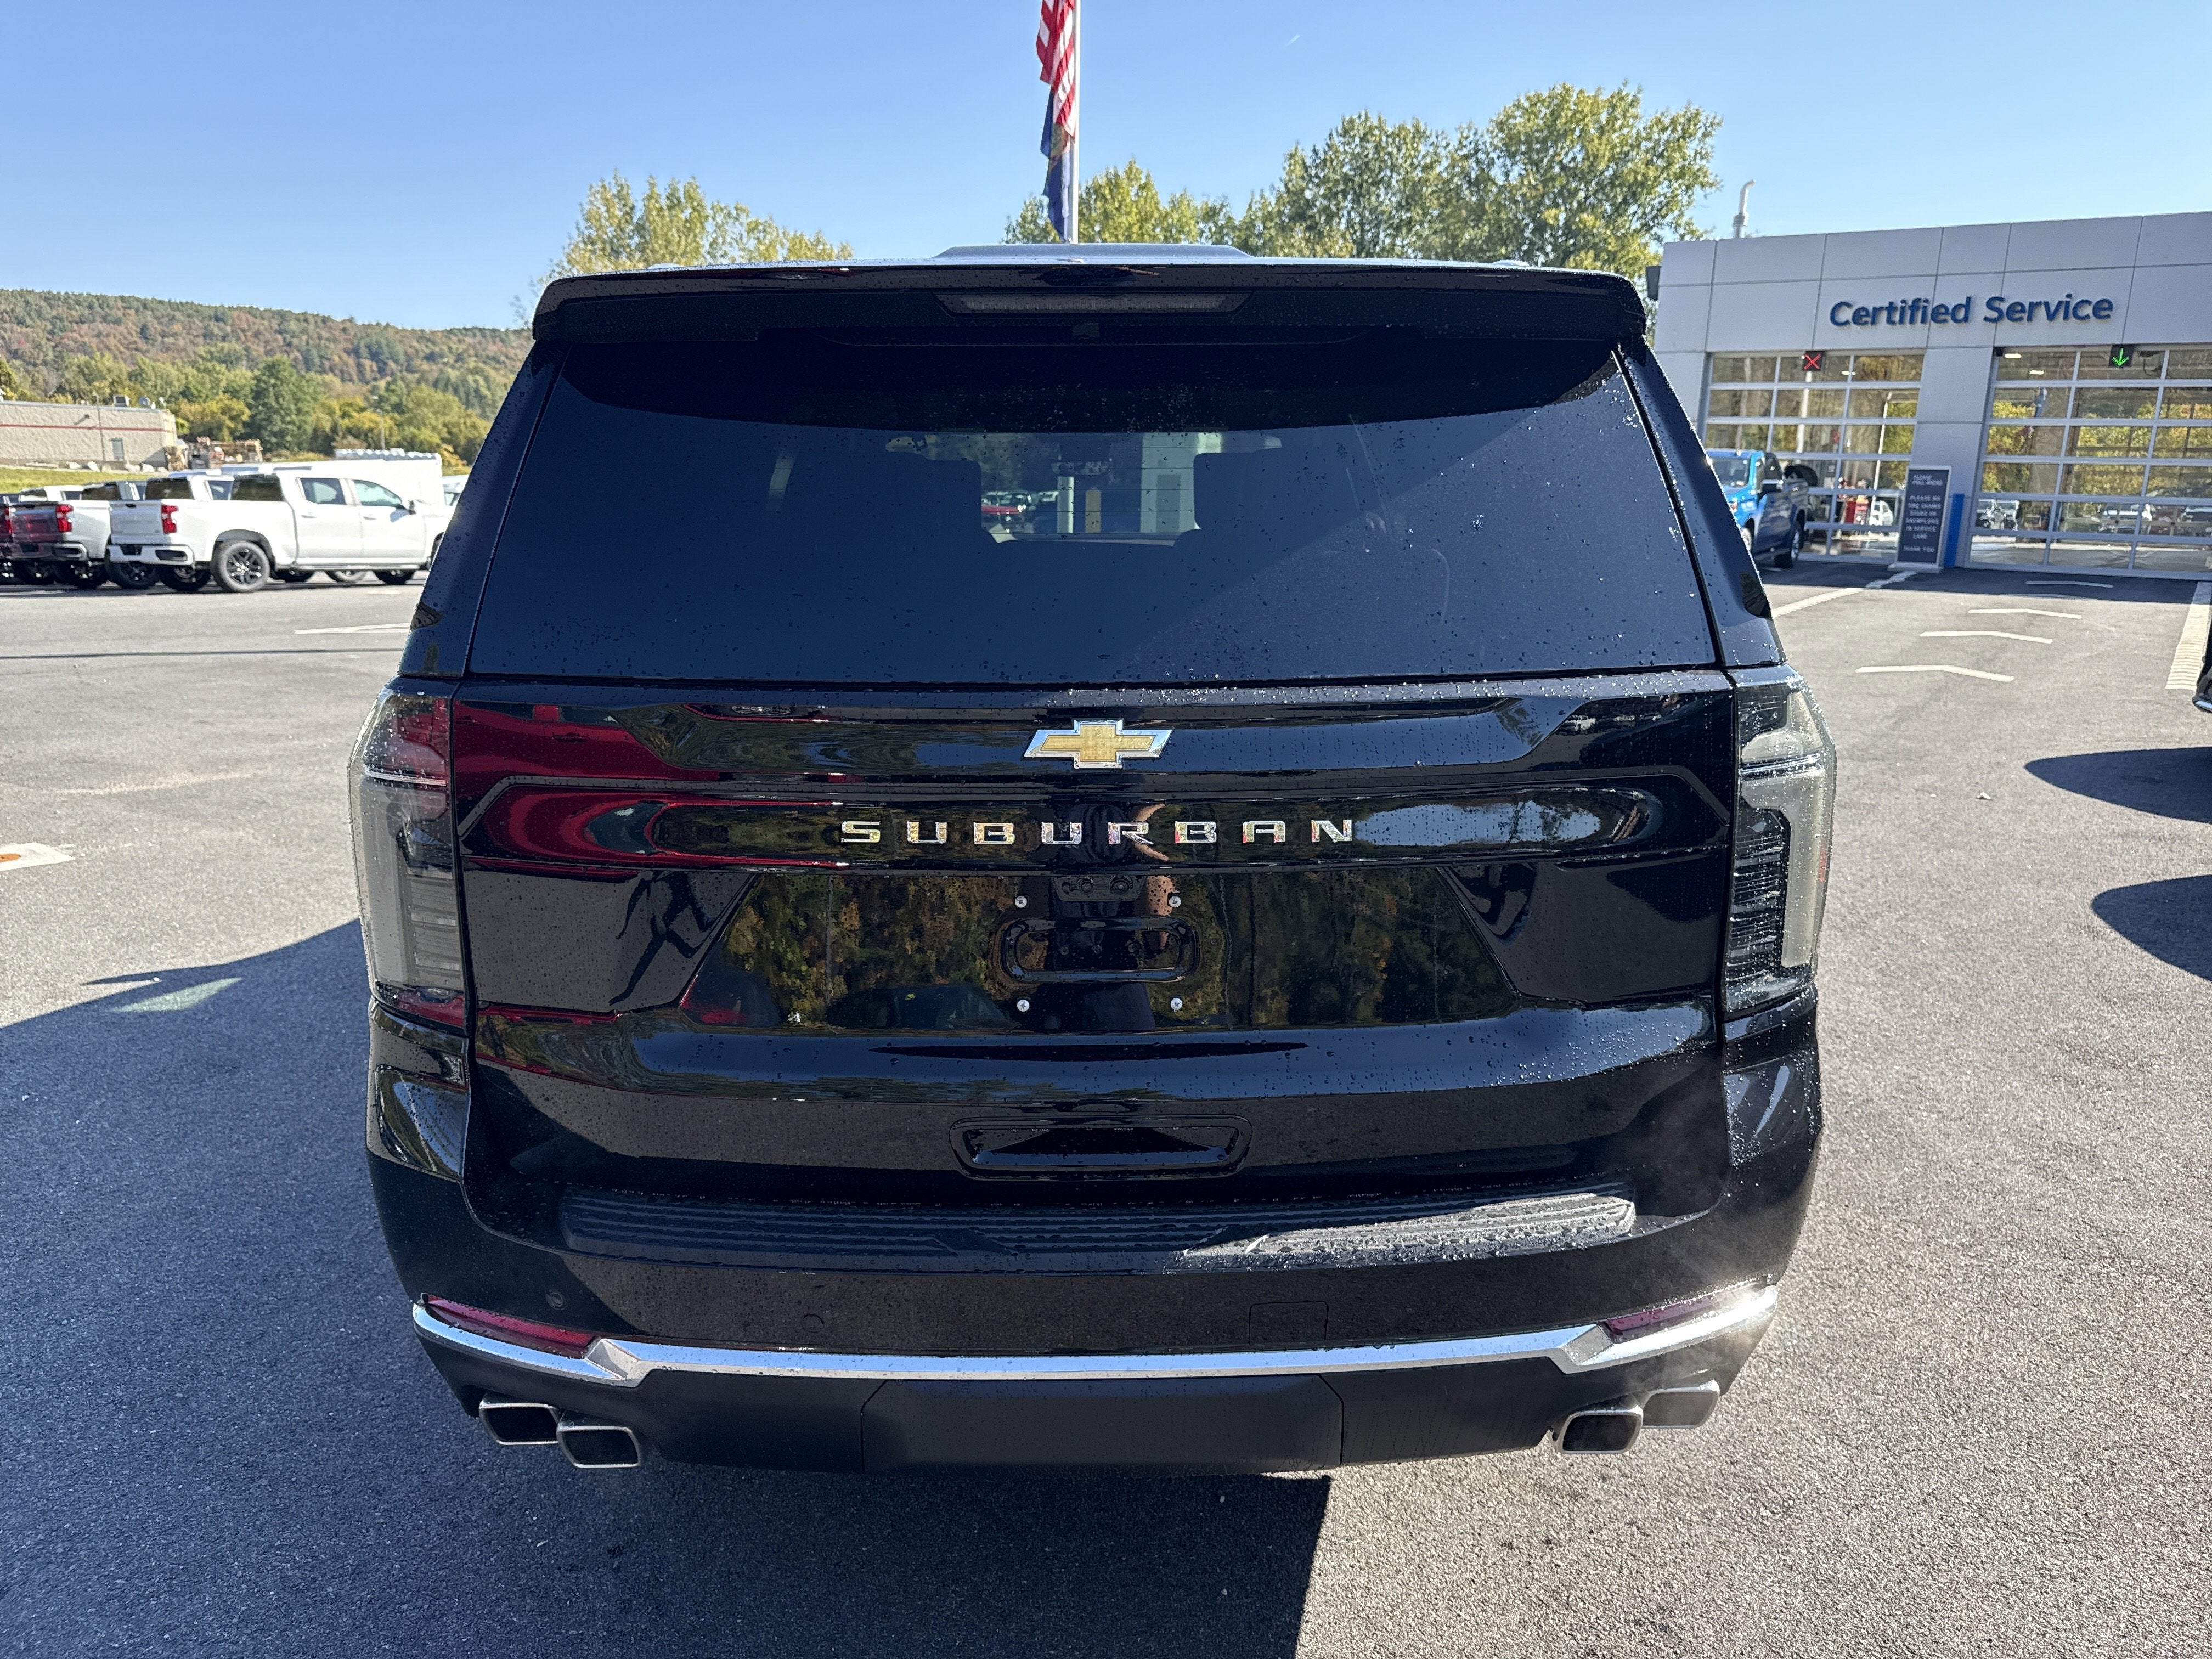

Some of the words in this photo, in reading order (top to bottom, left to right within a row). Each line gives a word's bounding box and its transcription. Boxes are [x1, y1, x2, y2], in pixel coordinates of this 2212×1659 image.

[1830, 296, 1972, 326] Certified
[1983, 293, 2113, 323] Service
[840, 819, 1353, 845] SUBURBAN
